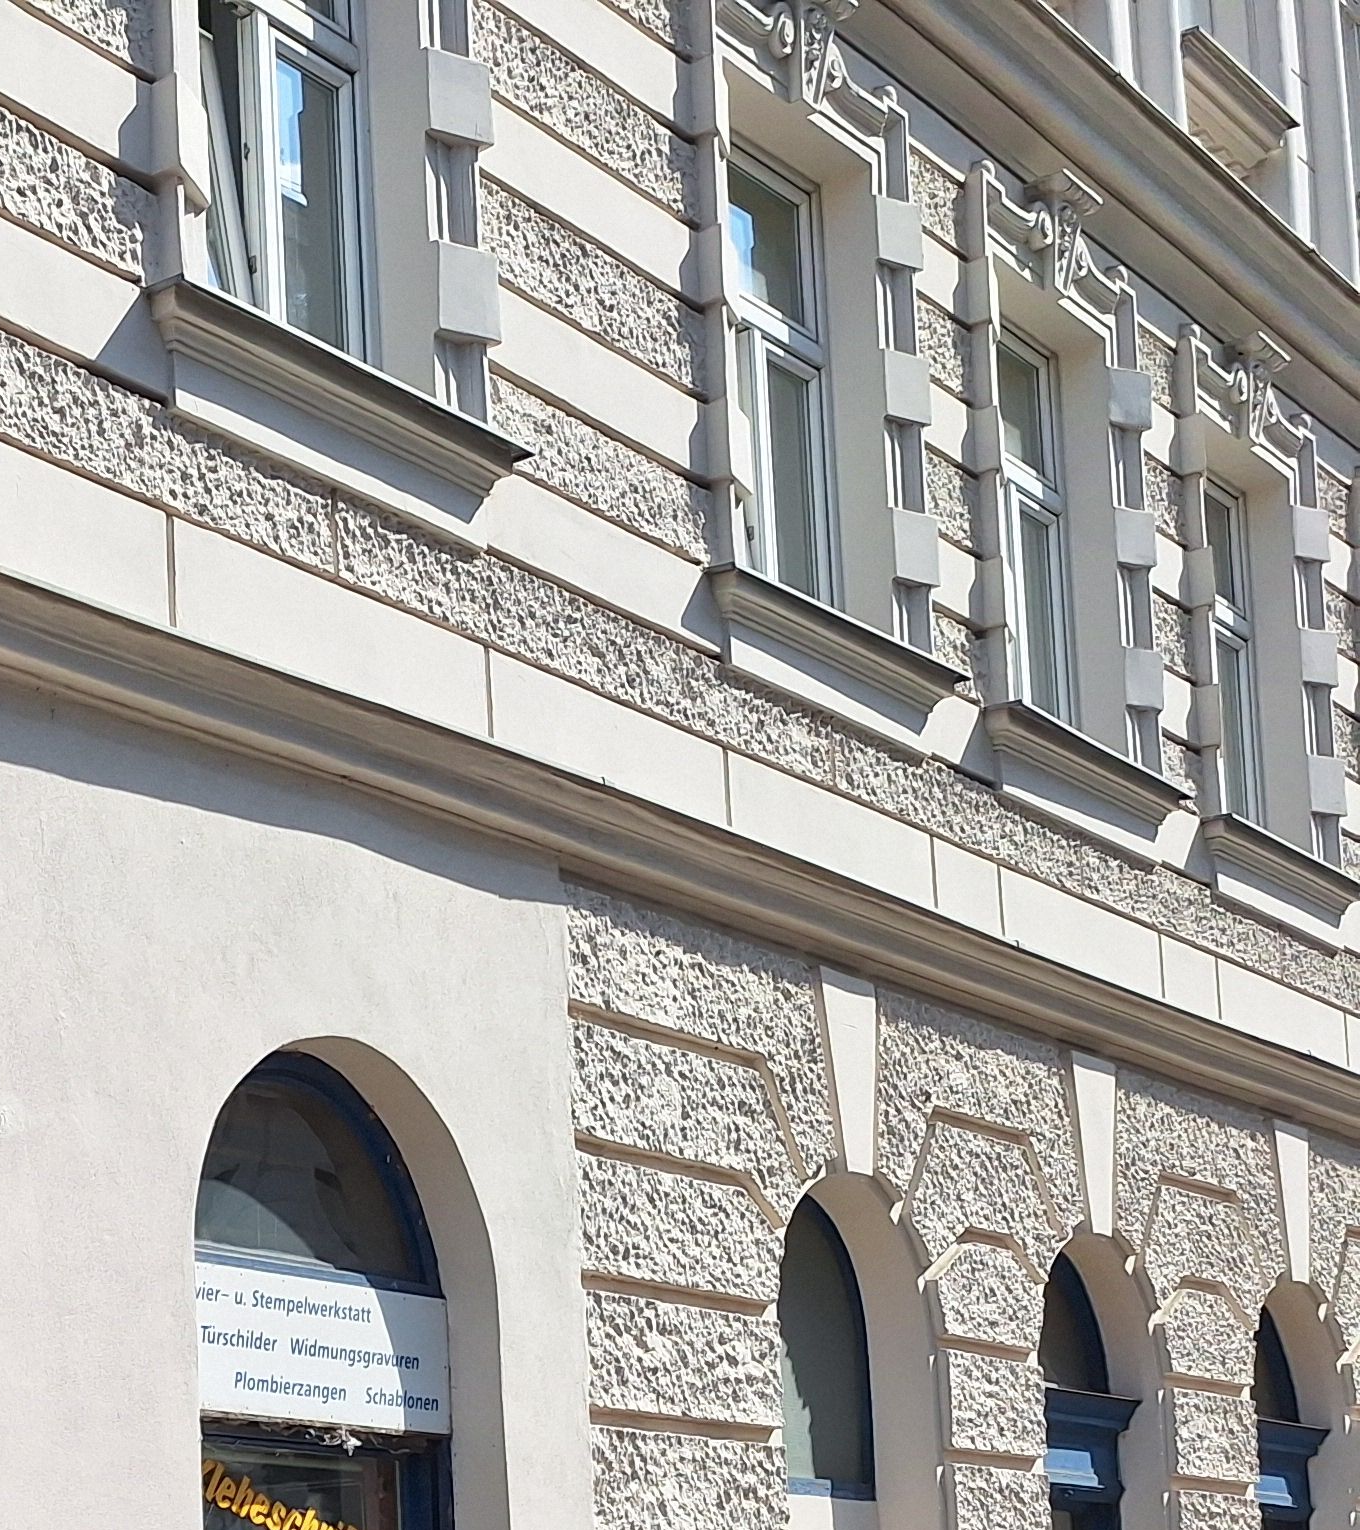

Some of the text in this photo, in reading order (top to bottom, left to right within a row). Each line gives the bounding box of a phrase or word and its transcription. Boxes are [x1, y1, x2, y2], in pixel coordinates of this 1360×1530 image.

[234, 1289, 247, 1306] u.
[251, 1289, 372, 1324] Stempelwerkstatt
[200, 1324, 420, 1371] Türschilder Widmungsgravuren
[234, 1371, 439, 1412] Plombierzangen Schablonen
